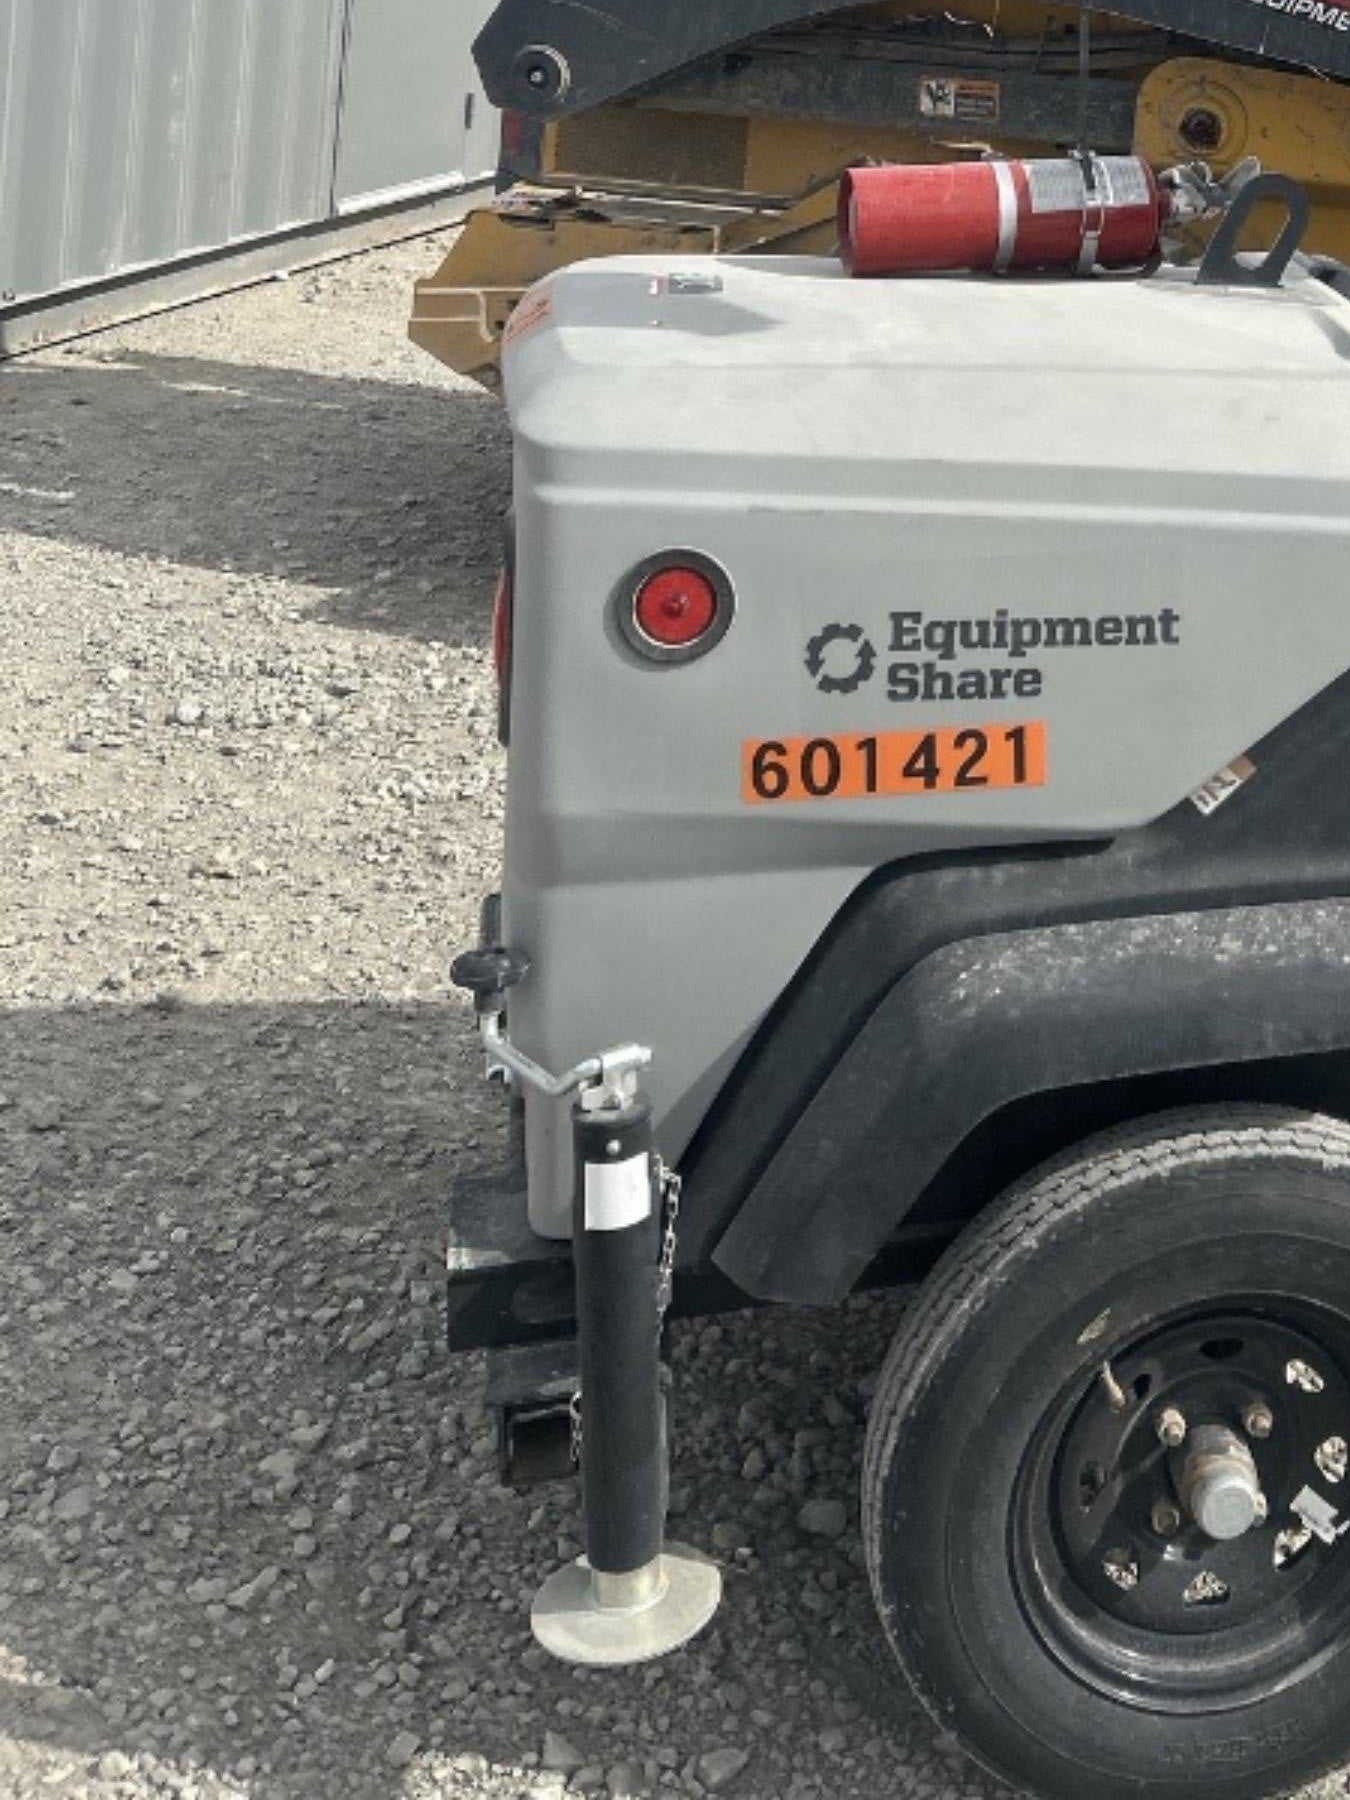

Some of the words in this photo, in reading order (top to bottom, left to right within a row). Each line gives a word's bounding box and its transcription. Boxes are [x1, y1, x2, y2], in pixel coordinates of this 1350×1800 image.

[887, 608, 1180, 660] Equipment
[886, 662, 1043, 701] Share
[751, 725, 1028, 799] 601421
